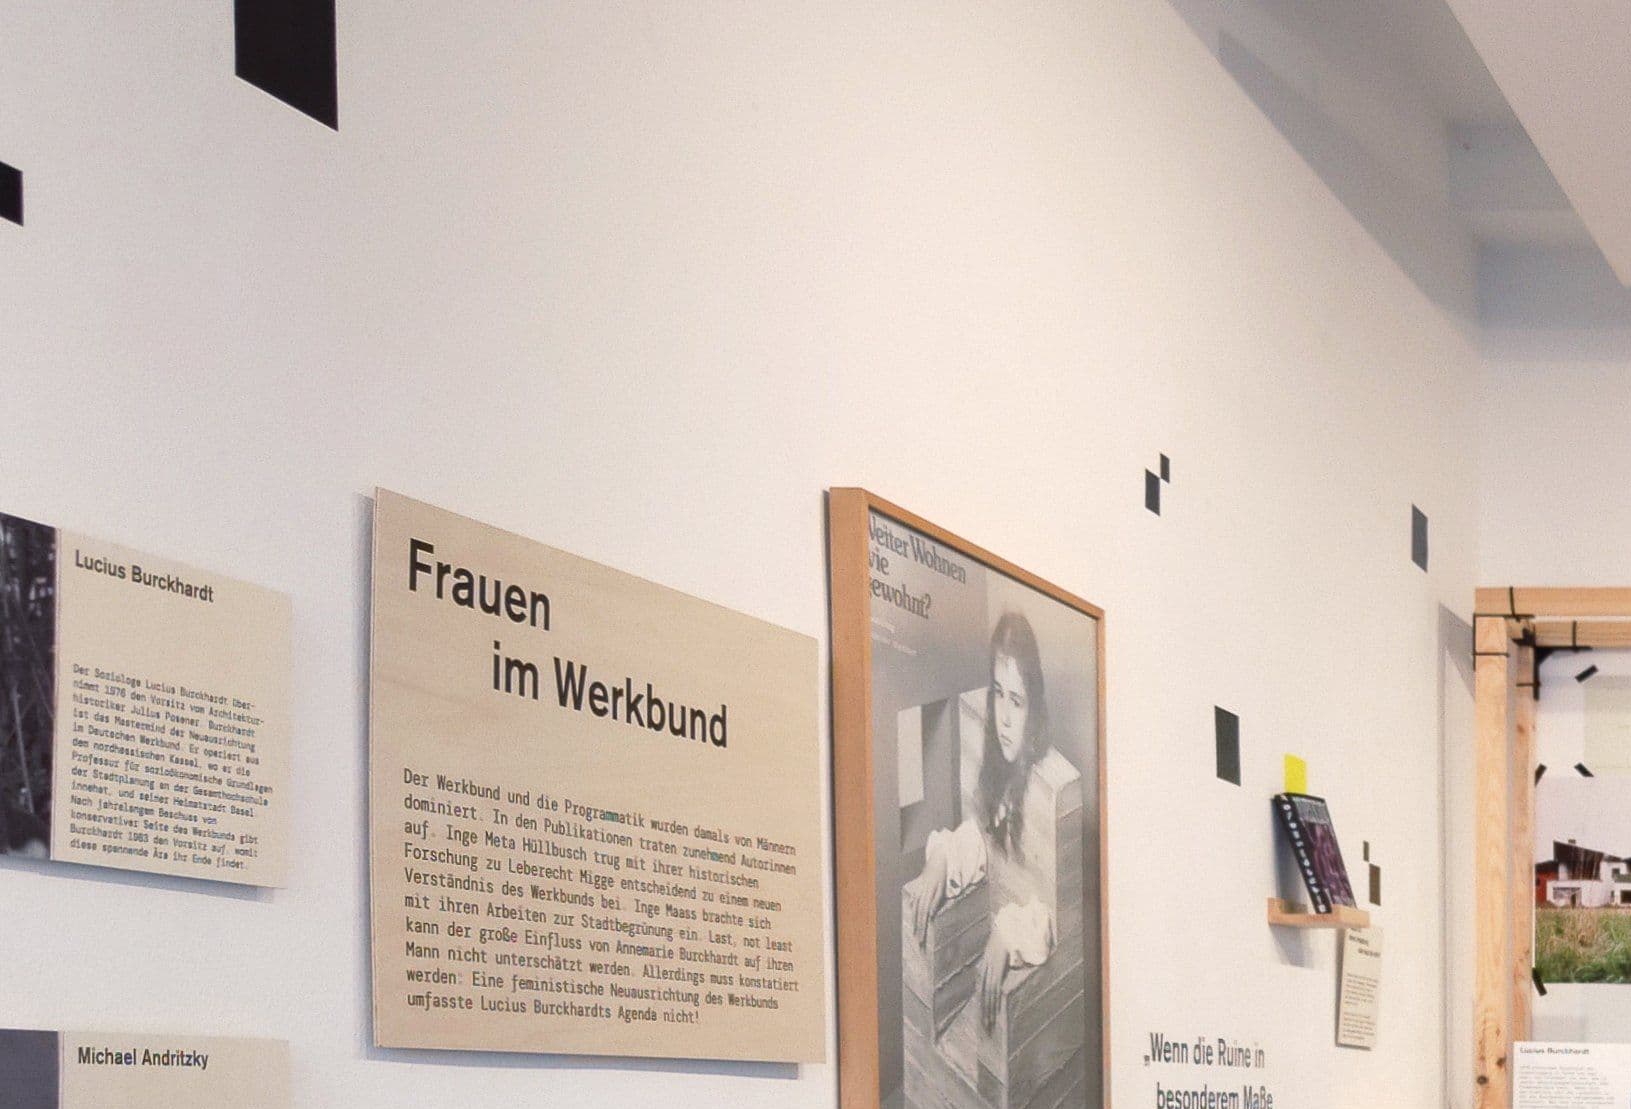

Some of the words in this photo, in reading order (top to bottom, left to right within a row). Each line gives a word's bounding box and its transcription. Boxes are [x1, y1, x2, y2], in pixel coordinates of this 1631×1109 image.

[75, 549, 126, 580] Lucius
[132, 565, 214, 603] Burckhardt
[409, 537, 550, 630] Frauen
[910, 535, 966, 584] Wohnen
[871, 577, 931, 619] ewohnt?
[493, 641, 538, 699] im
[554, 657, 727, 747] Werkbund
[404, 768, 429, 787] Der
[437, 774, 500, 801] Werkbund
[508, 789, 529, 806] und
[537, 794, 558, 812] die
[565, 800, 644, 828] Programmatik
[651, 818, 688, 836] wurden
[694, 825, 729, 844] damals
[735, 834, 751, 848] von
[757, 837, 796, 856] Männern
[404, 795, 483, 822] dominiert.
[494, 810, 508, 826] In
[516, 813, 537, 831] den
[544, 818, 632, 848] Publikationen
[640, 837, 677, 855] traten
[683, 846, 735, 866] zunehmend
[741, 854, 796, 876] Autorinnen
[78, 1047, 136, 1065] Michael
[142, 1049, 208, 1070] Andritzky
[1144, 1032, 1189, 1066] „Wenn
[1193, 1037, 1213, 1066] die
[1218, 1038, 1251, 1067] Ruine
[1254, 1042, 1264, 1068] in
